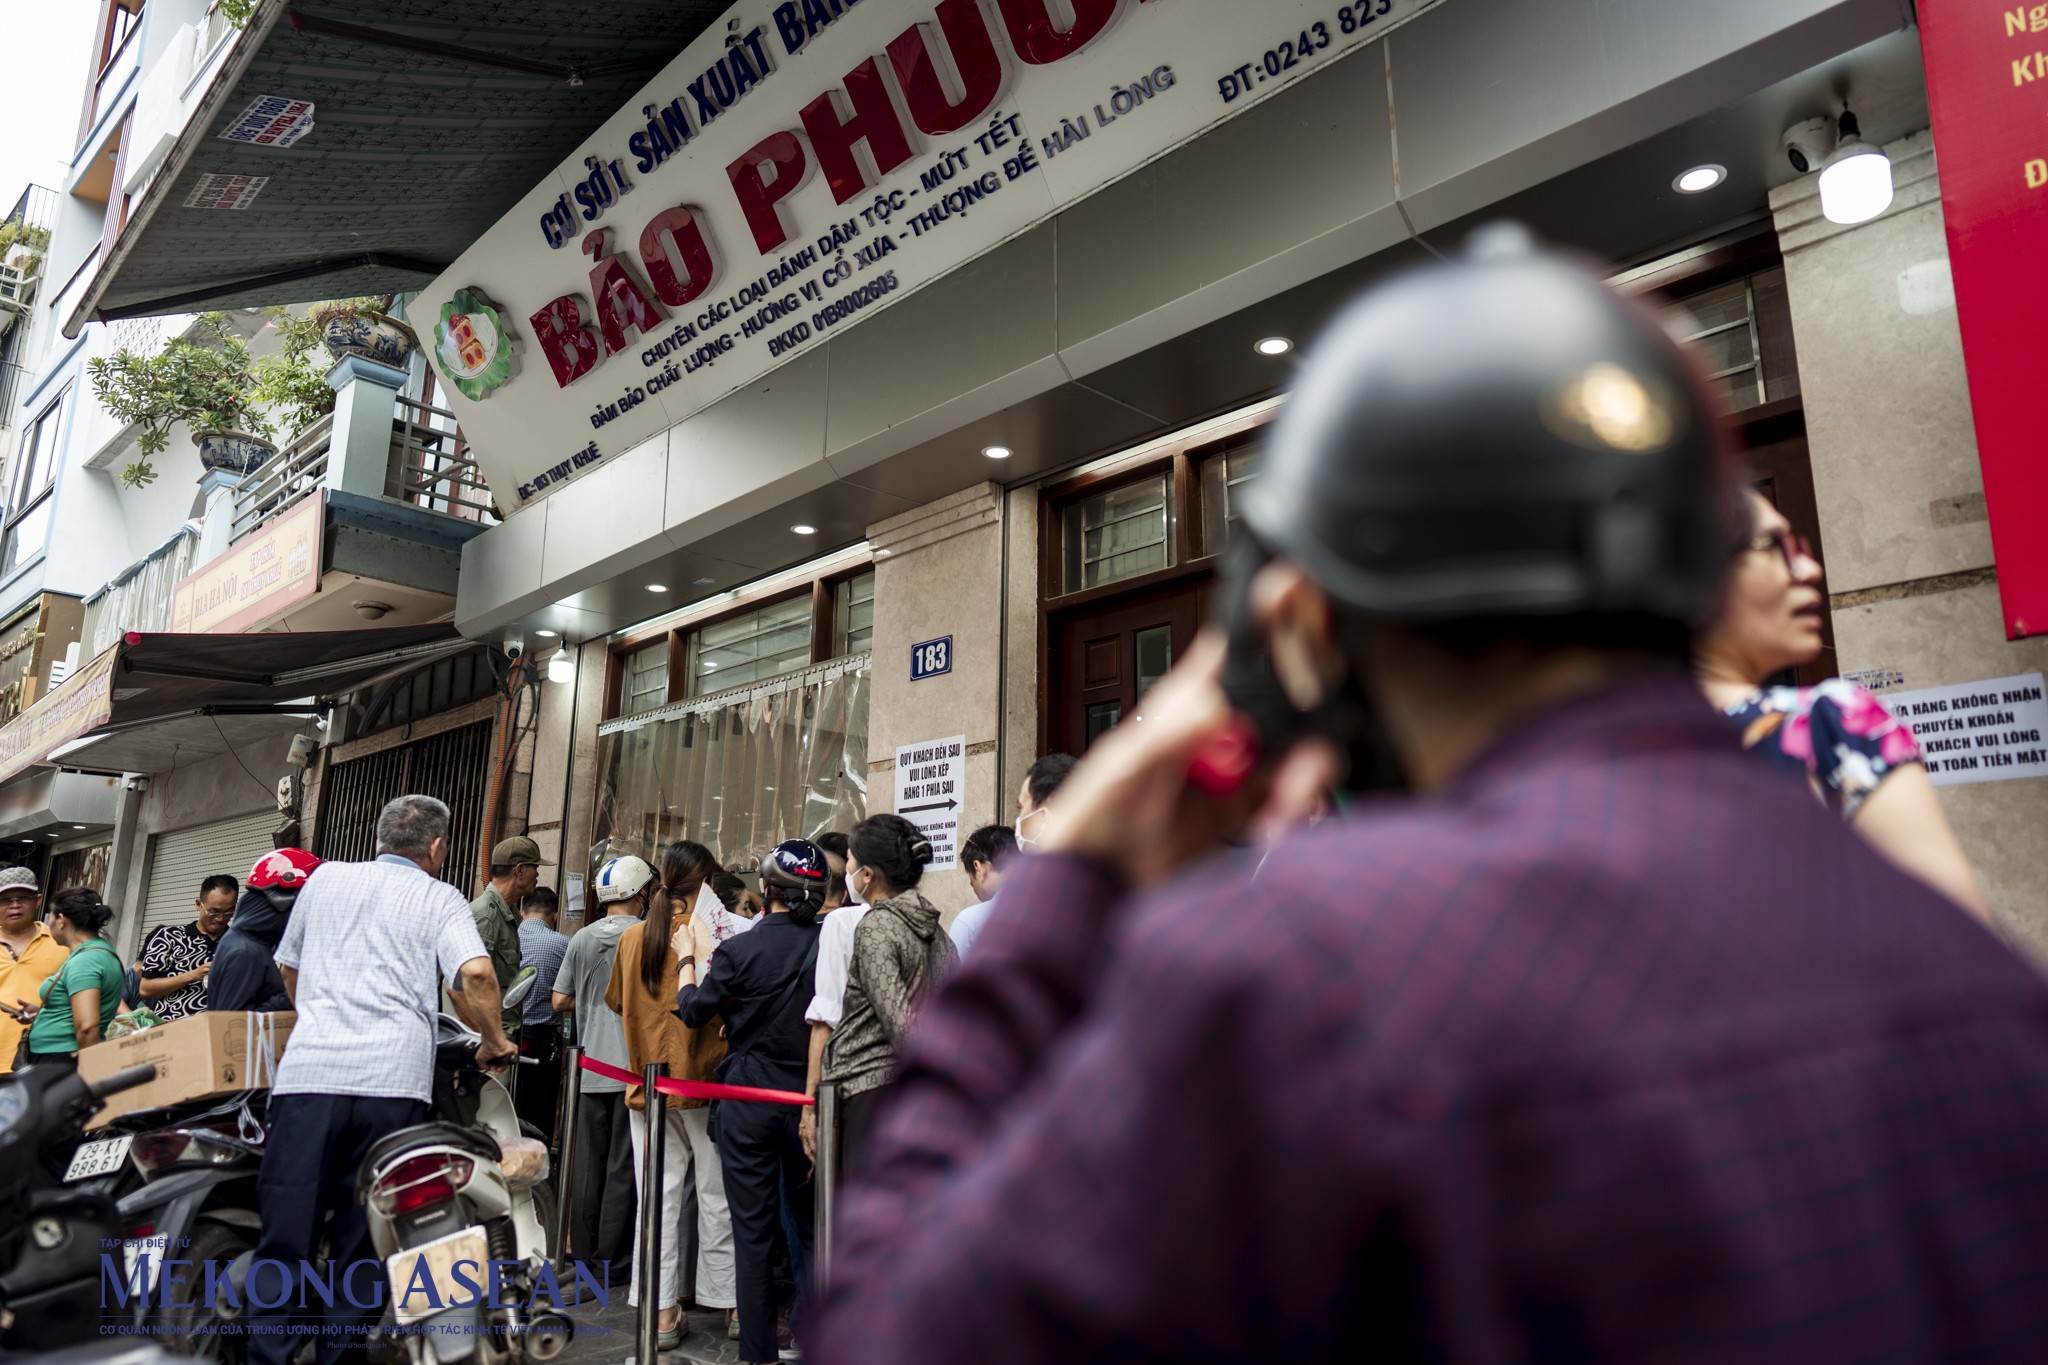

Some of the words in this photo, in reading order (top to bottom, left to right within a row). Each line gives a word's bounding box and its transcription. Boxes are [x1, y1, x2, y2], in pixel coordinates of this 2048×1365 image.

[1217, 22, 1330, 103] ĐT:0243
[541, 192, 578, 249] CƠ
[629, 98, 697, 174] SẢN
[687, 19, 775, 127] XUẤT
[590, 403, 618, 429] ĐẢM
[618, 387, 644, 413] BẢO
[646, 362, 682, 396] CHẤT
[685, 333, 734, 374] LƯỢNG
[740, 293, 801, 339] HƯƠNG
[799, 280, 822, 301] VỊ
[822, 248, 851, 288] CỔ
[853, 234, 898, 271] XƯA
[907, 171, 1001, 237] THƯỢNG
[1003, 139, 1039, 182] ĐẾ
[1041, 115, 1090, 159] HÀI
[1093, 65, 1176, 127] LÒNG
[642, 325, 697, 367] CHUYÊN
[697, 300, 731, 331] CÁC
[729, 278, 769, 315] LOẠI
[767, 246, 818, 288] BÁNH
[817, 218, 861, 256] DÂN
[860, 189, 906, 226] TỘC
[919, 147, 968, 193] MỨT
[974, 111, 1022, 156] TẾT
[529, 206, 716, 388] BẢO
[767, 321, 811, 357] ĐKKD
[546, 459, 573, 481] THỤY
[571, 440, 602, 470] KHUÊ
[914, 641, 947, 673] 183
[1912, 699, 1947, 715] HÀNG
[1952, 693, 1998, 710] KHÔNG
[2002, 687, 2042, 704] NHẬN
[900, 750, 912, 767] QUÝ
[913, 747, 933, 764] KHÁCH
[935, 742, 946, 759] ĐẾN
[949, 743, 960, 757] SAU
[1926, 738, 1971, 753] KHÁCH
[1975, 733, 1999, 748] VUI
[2003, 729, 2041, 745] LÒNG
[909, 768, 919, 781] VUI
[921, 765, 936, 780] LÒNG
[938, 760, 949, 777] XẾP
[1942, 756, 1978, 772] TOÁN
[1981, 750, 2013, 767] TIỀN
[2017, 748, 2047, 765] MẶT
[904, 784, 920, 799] HÀNG
[926, 781, 940, 796] PHÍA
[942, 780, 954, 794] SAU
[81, 1139, 122, 1160] 29-K1
[69, 1154, 120, 1178] 988.61
